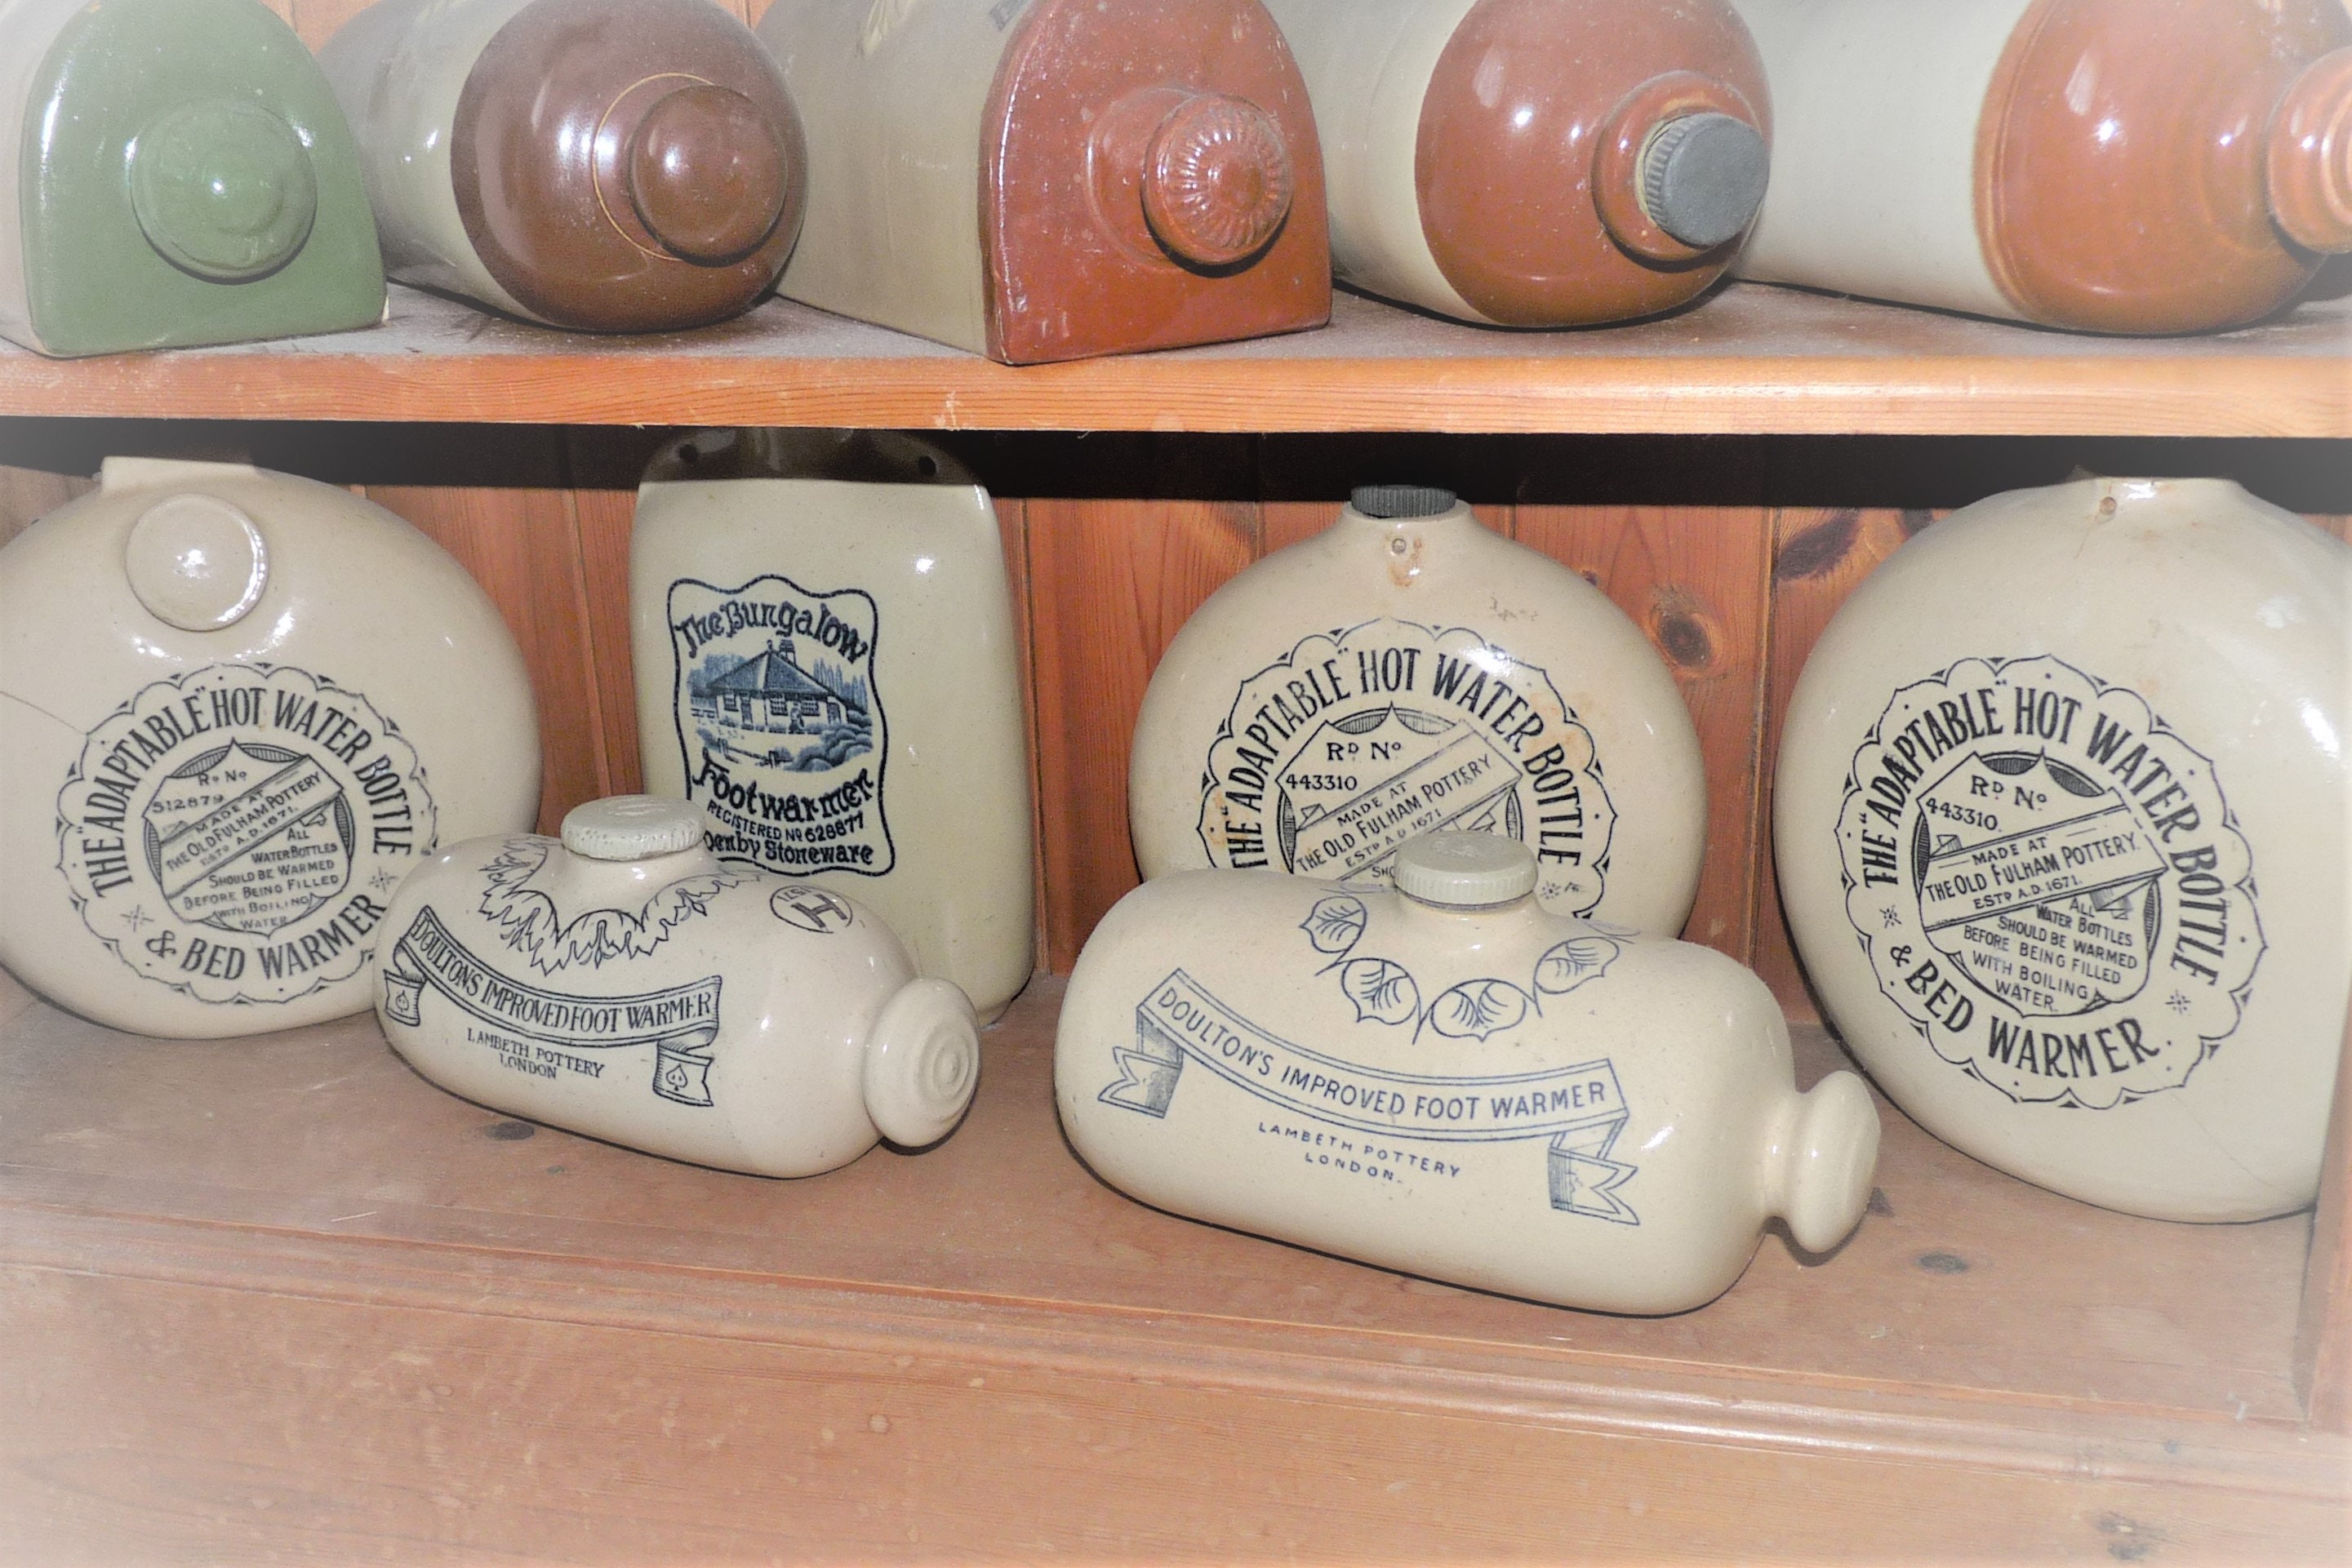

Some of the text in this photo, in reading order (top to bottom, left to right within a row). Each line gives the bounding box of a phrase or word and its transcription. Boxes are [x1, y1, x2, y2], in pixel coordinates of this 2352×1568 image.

[678, 600, 869, 664] The Bungalow
[1358, 647, 1421, 695] HOT
[1432, 653, 1544, 753] WATER
[1522, 743, 1583, 866] BOTTLE
[82, 836, 133, 897] THE
[210, 687, 267, 729] HOT
[274, 689, 371, 766] WATER
[353, 754, 413, 855] BOTTLE
[152, 793, 225, 813] 512879
[1286, 774, 1358, 791] 443310
[1336, 781, 1407, 827] MADE AT
[167, 771, 322, 872] THE OLD FULHAM POTTERY
[194, 789, 265, 834] MADE AT
[707, 799, 782, 841] REGISTERED
[1296, 753, 1491, 873] THE OLD FULHAM POTTERY
[1412, 808, 1443, 830] 1671
[251, 843, 338, 864] WATER BOTTLES
[287, 828, 309, 841] ALL
[702, 830, 874, 864] Denby Stoneware
[1861, 829, 1899, 888] THE
[2013, 686, 2082, 744] HOT
[2086, 712, 2201, 844] WATER
[2168, 844, 2227, 986] BOTTLE
[1972, 837, 2047, 865] MADE AT
[184, 874, 339, 909] BEFORE BEING FILLED
[209, 860, 335, 888] SHOULD BE WARMED
[1926, 881, 1955, 902] THE
[1954, 873, 1988, 895] OLD
[1991, 853, 2061, 886] FULHAM
[217, 906, 245, 917] WITH
[240, 916, 287, 930] WATER
[790, 894, 847, 928] H
[2036, 903, 2133, 947] WATER BOTTLES
[2070, 899, 2095, 918] ALL
[145, 895, 386, 980] & BED WARMER
[1963, 925, 2121, 984] BEFORE BEING FILLED
[1998, 916, 2137, 970] SHOULD BE WARMED
[1890, 944, 1912, 968] &
[1905, 958, 1974, 1033] BED
[1972, 950, 2088, 1000] WITH BOILING
[481, 979, 569, 1028] IMPROVED
[570, 1006, 622, 1033] FOOT
[627, 991, 712, 1030] WARMER
[467, 1028, 605, 1078] LAMBETH POTTERY
[500, 1053, 557, 1080] LONDON
[1158, 987, 1606, 1121] DOULTON'S IMPROVED FOOT WARMER
[1259, 1122, 1461, 1178] LAMBETH POTTERY
